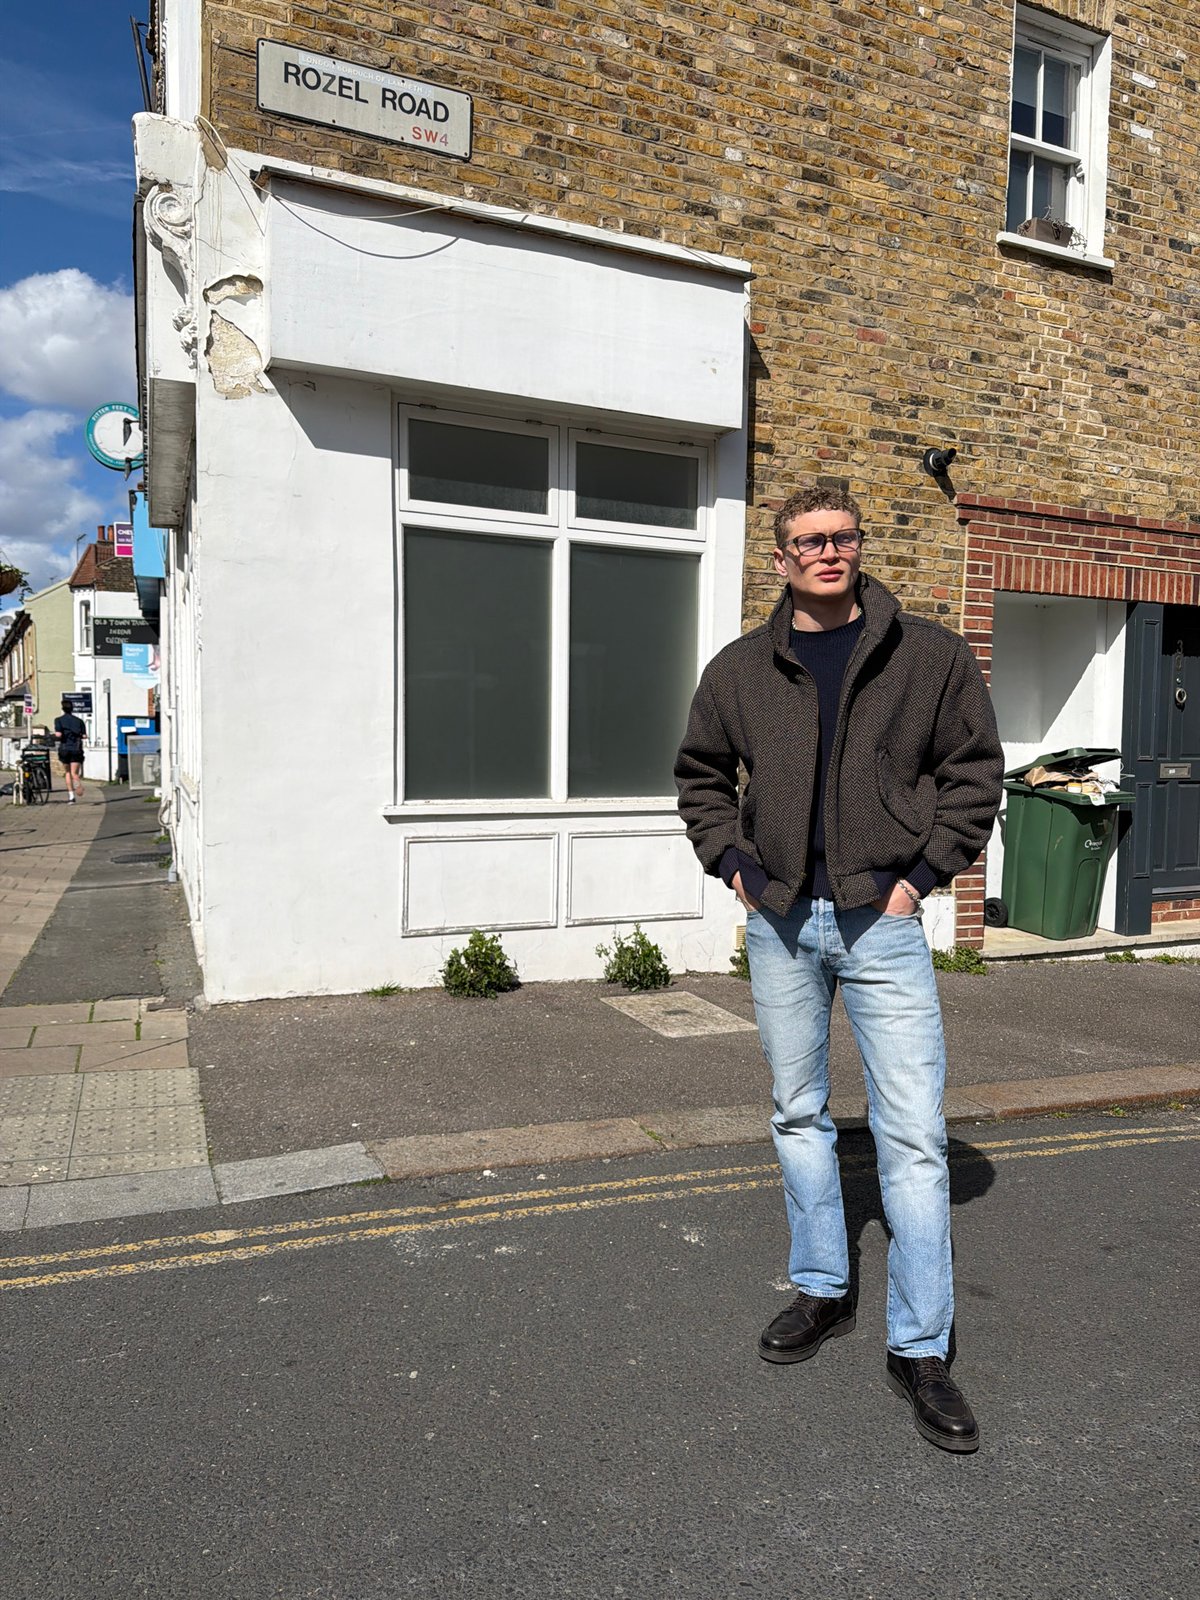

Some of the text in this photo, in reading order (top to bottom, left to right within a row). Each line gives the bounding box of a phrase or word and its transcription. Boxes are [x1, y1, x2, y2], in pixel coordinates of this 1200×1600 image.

[337, 66, 374, 80] BOROUGH
[284, 61, 450, 123] ROZEL ROAD
[411, 126, 449, 146] SW4
